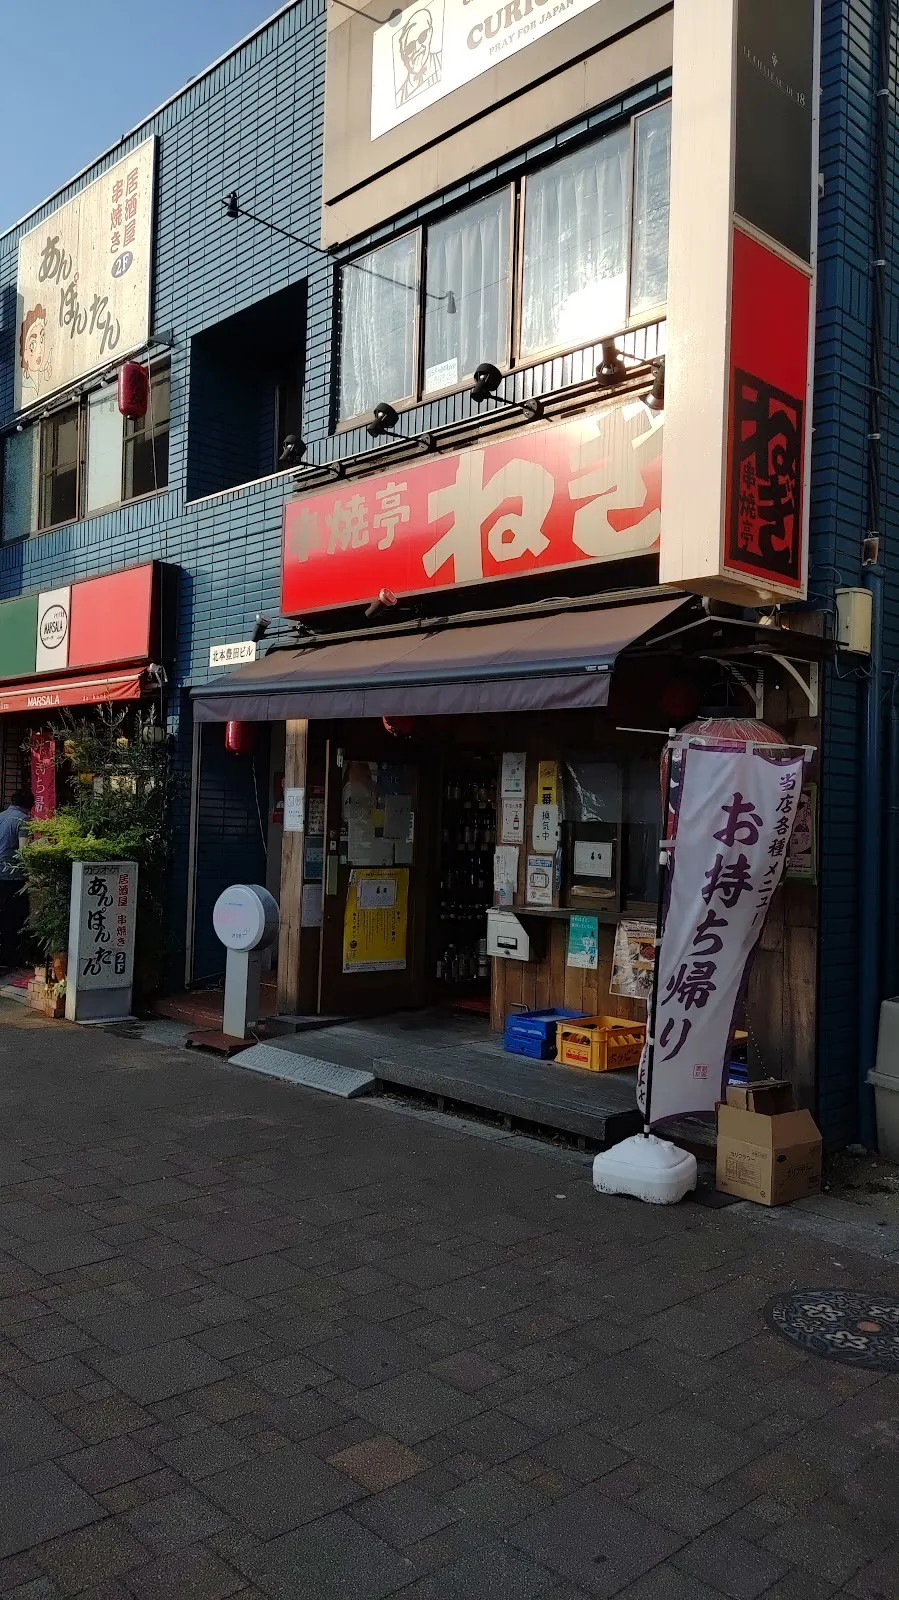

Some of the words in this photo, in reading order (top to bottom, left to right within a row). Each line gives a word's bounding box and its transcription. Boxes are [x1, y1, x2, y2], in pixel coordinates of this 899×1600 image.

[489, 32, 516, 56] PRAY
[517, 20, 537, 39] FOR
[539, 0, 574, 24] JAPAN
[796, 91, 806, 107] 18
[110, 179, 125, 253] 串焼き
[123, 167, 138, 248] 居酒屋
[114, 256, 130, 276] 2F
[289, 482, 411, 563] 串焼亭
[44, 620, 63, 634] MARSALA
[213, 645, 254, 662] 北本豊田ビル
[27, 694, 60, 707] MARSALA
[542, 811, 550, 841] 換気中
[752, 772, 796, 927] 当店各種メニュー
[118, 873, 129, 907] 居酒屋
[82, 876, 114, 976] あんぽんたん
[116, 914, 127, 947] 串焼き
[659, 791, 763, 1063] お持ち帰り
[116, 953, 125, 973] 2F
[609, 1048, 640, 1064] ホッピー
